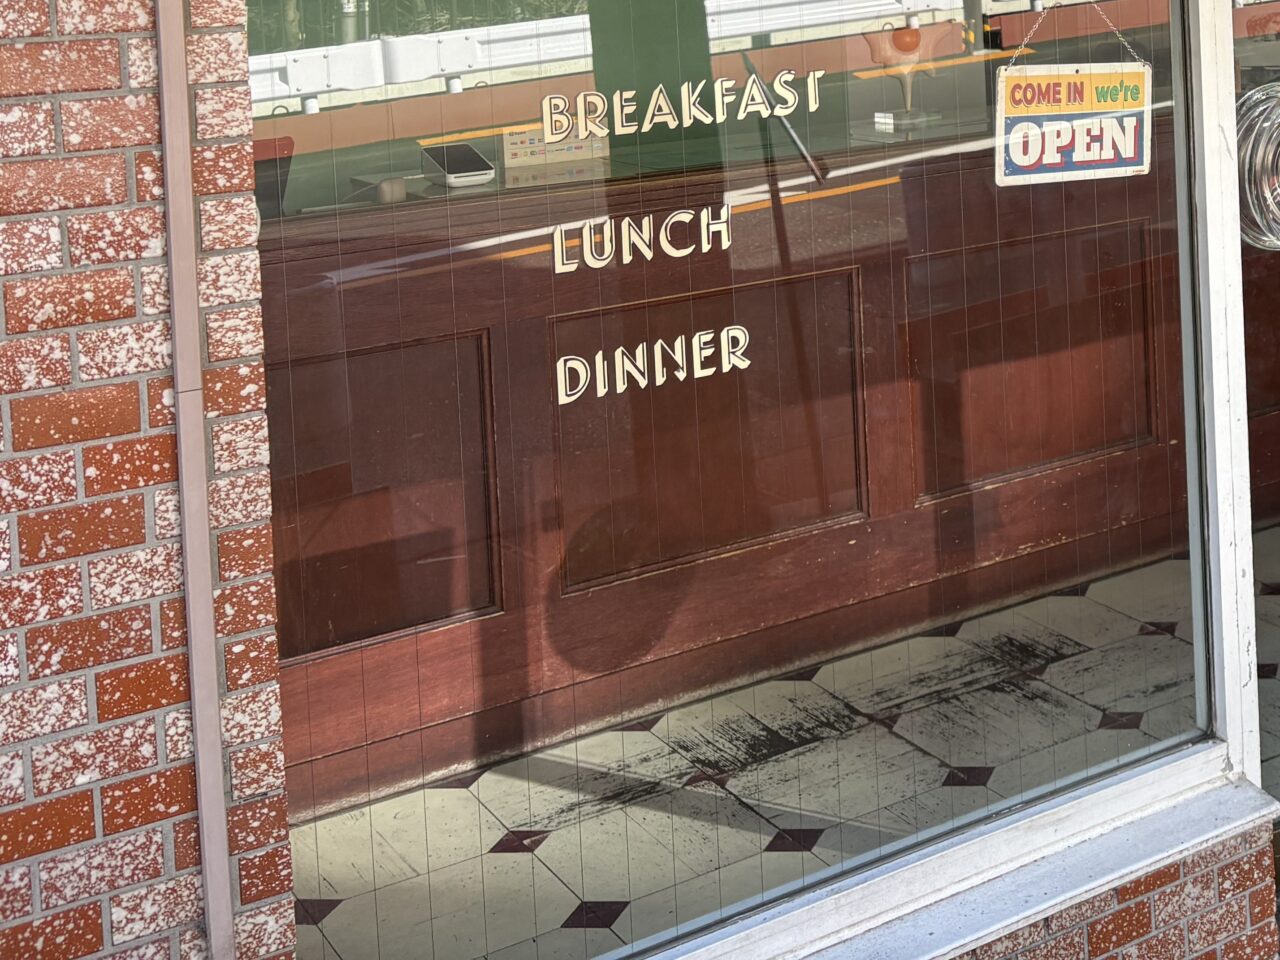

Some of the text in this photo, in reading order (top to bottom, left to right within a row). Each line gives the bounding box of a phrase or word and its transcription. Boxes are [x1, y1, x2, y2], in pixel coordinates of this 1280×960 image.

[542, 69, 826, 144] BREAKFAST
[1010, 80, 1140, 107] COME IN we're
[1009, 117, 1139, 169] OPEN
[552, 203, 732, 275] LUNCH
[556, 325, 751, 406] DINNER
